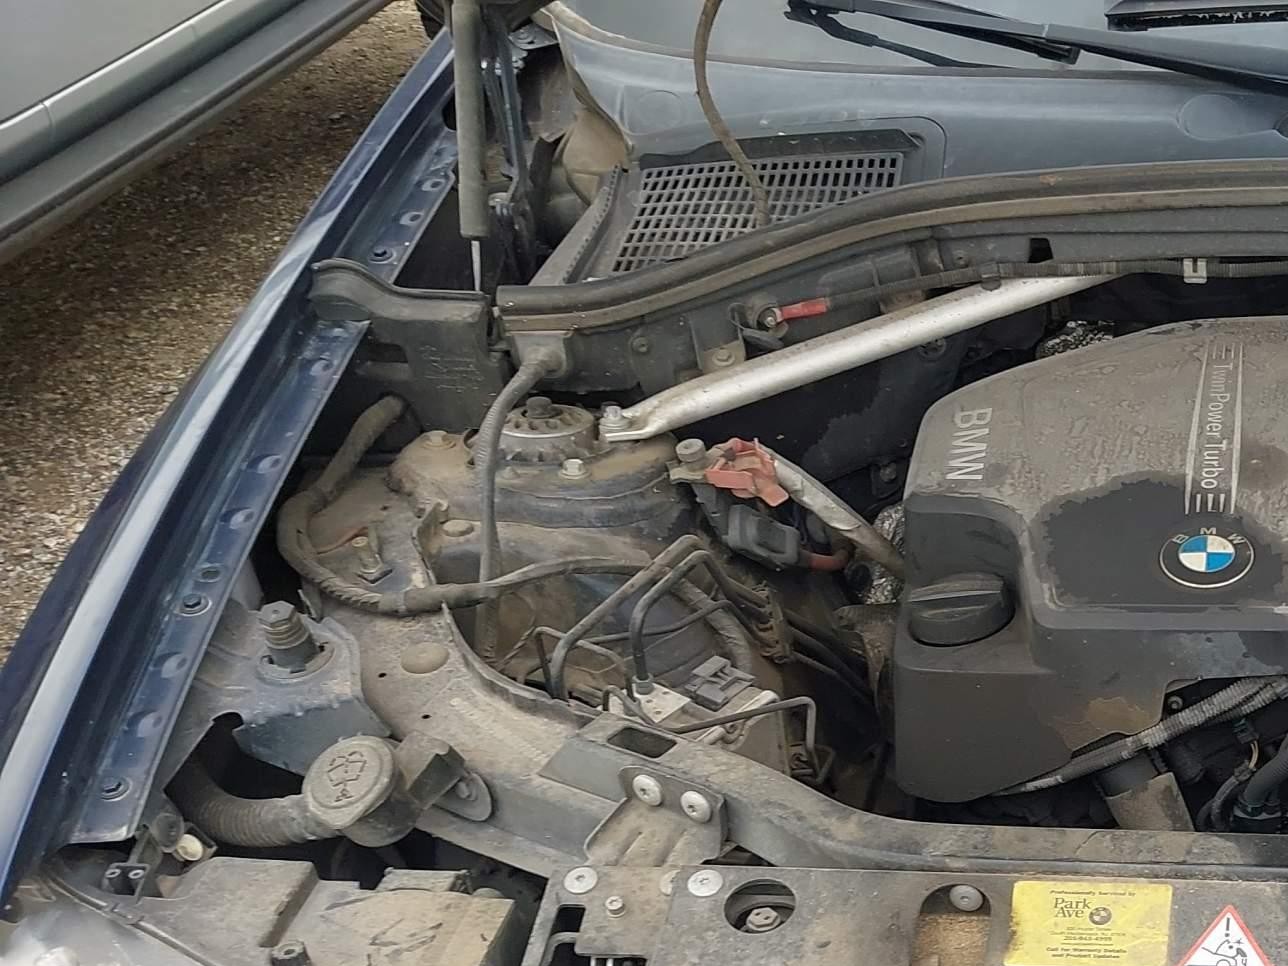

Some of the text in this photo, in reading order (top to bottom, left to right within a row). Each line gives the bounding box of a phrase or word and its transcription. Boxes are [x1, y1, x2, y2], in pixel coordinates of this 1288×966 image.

[946, 408, 992, 480] BMW
[1172, 527, 1247, 545] BMW
[1054, 897, 1092, 909] Park
[1054, 907, 1084, 918] Ave
